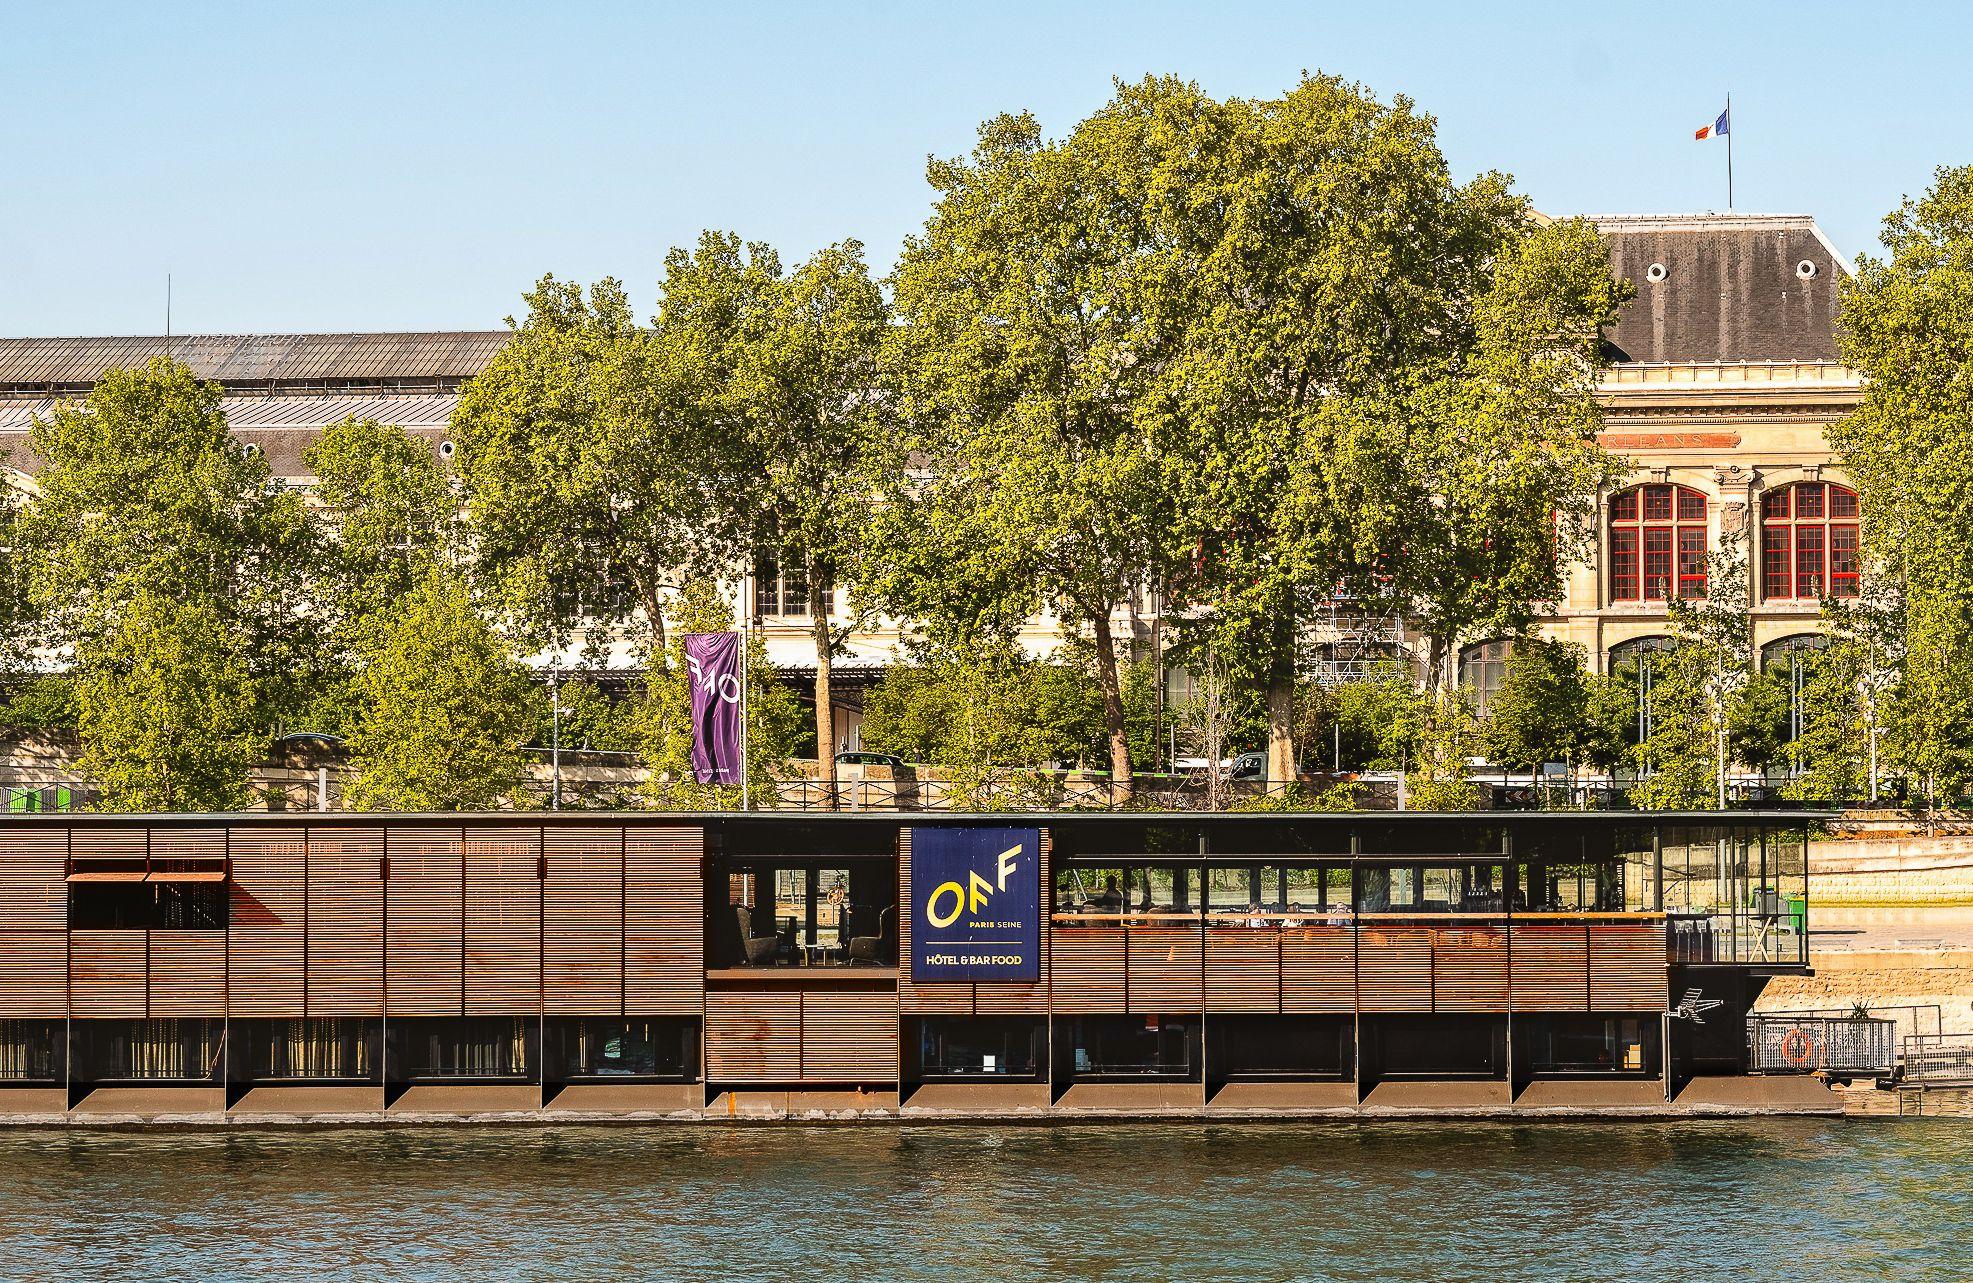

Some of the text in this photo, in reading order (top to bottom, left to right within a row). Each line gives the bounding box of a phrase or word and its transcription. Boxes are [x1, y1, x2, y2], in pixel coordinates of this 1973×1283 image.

[926, 843, 1023, 929] OFF
[926, 953, 1022, 965] HÔTEL & BAR FOOD
